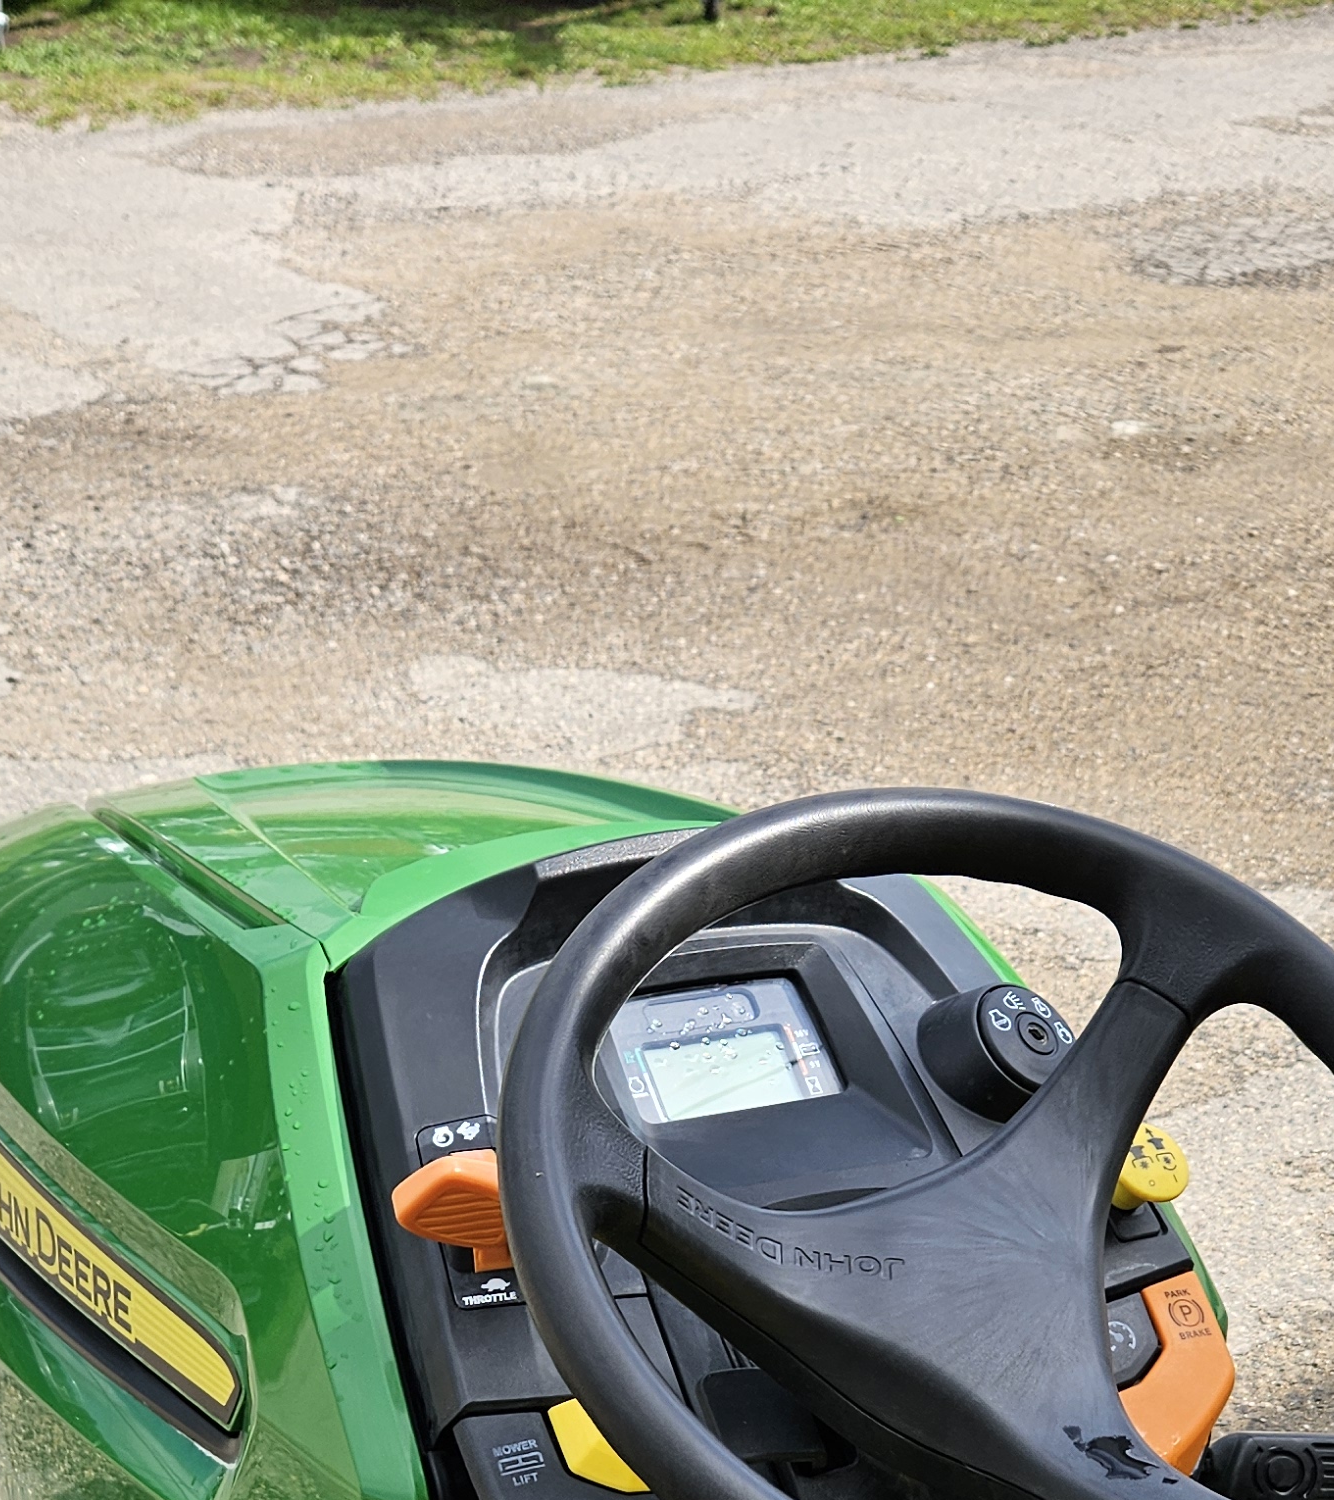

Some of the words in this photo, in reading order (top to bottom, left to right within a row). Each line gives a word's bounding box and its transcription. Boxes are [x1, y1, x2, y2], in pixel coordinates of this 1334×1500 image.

[677, 1185, 783, 1264] DEERE
[36, 1207, 132, 1334] DEERE
[794, 1247, 904, 1280] JOHN
[462, 1291, 517, 1306] THROTTLE
[1164, 1289, 1191, 1298] PARK
[1179, 1328, 1212, 1340] BRAKE
[492, 1439, 538, 1457] MOWER
[512, 1472, 538, 1486] LIFT
